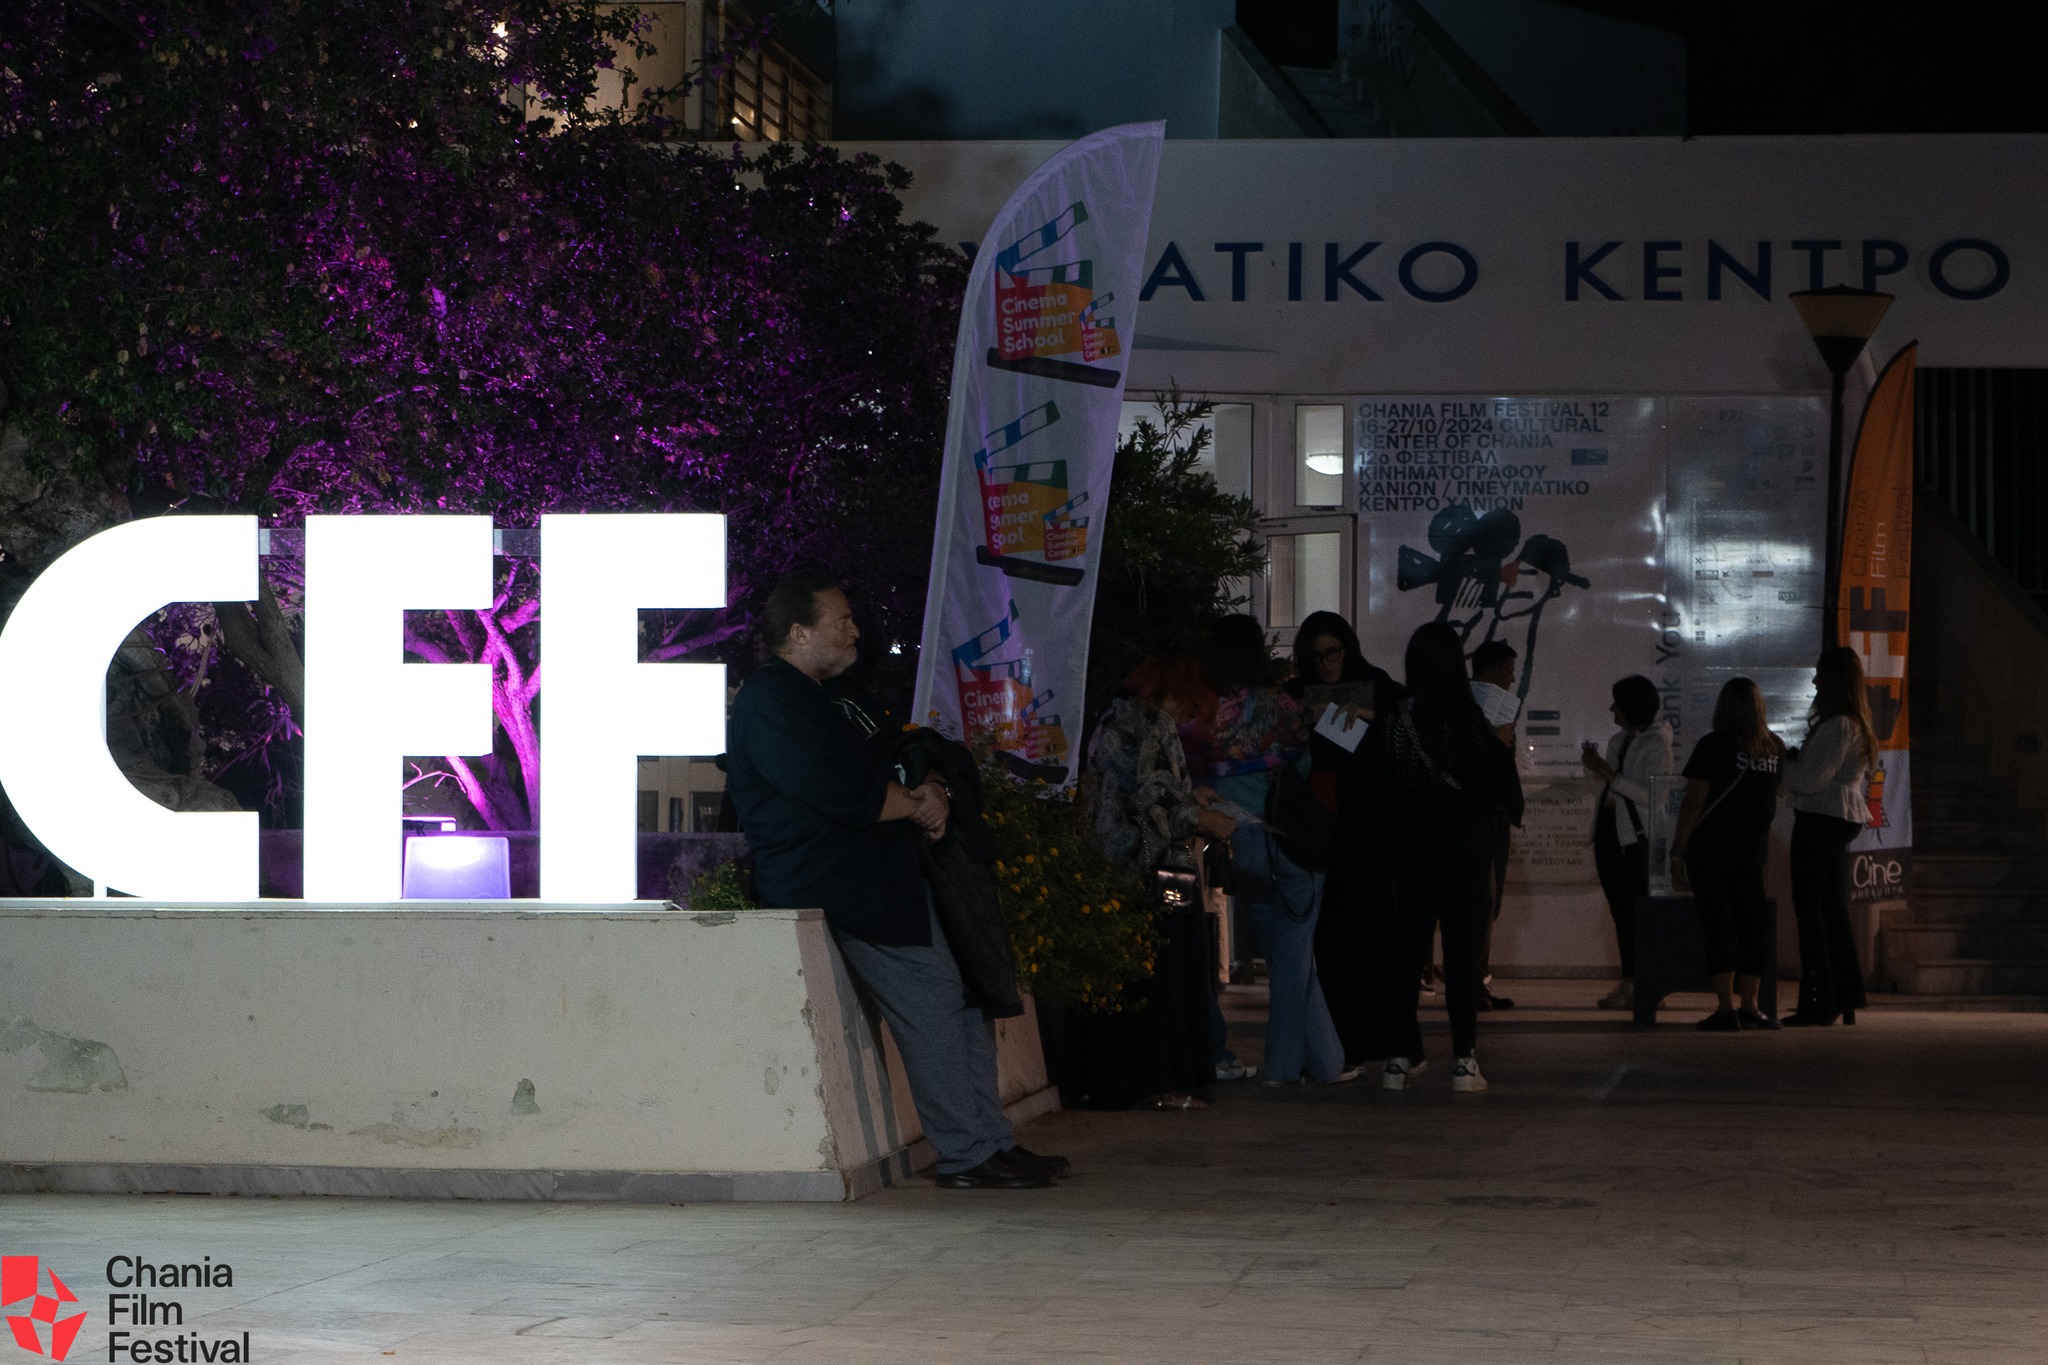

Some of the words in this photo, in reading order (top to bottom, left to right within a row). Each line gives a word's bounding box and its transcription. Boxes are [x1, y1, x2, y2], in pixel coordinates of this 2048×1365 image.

[1001, 294, 1069, 315] Cinema
[1003, 311, 1076, 334] Summer
[1004, 329, 1066, 353] School
[1359, 403, 1435, 418] CHANIA
[1441, 403, 1486, 418] FILM
[1494, 402, 1585, 418] FESTIVAL
[1590, 402, 1610, 418] 12
[1359, 418, 1494, 435] 16-27/10/2024
[1500, 418, 1604, 433] CULTURAL
[1359, 434, 1438, 449] CENTER
[1445, 434, 1471, 449] OF
[1477, 434, 1554, 449] CHANIA
[1870, 521, 1887, 578] Film
[0, 513, 727, 900] CFF
[1736, 751, 1779, 774] Staff
[1853, 855, 1903, 889] Cine
